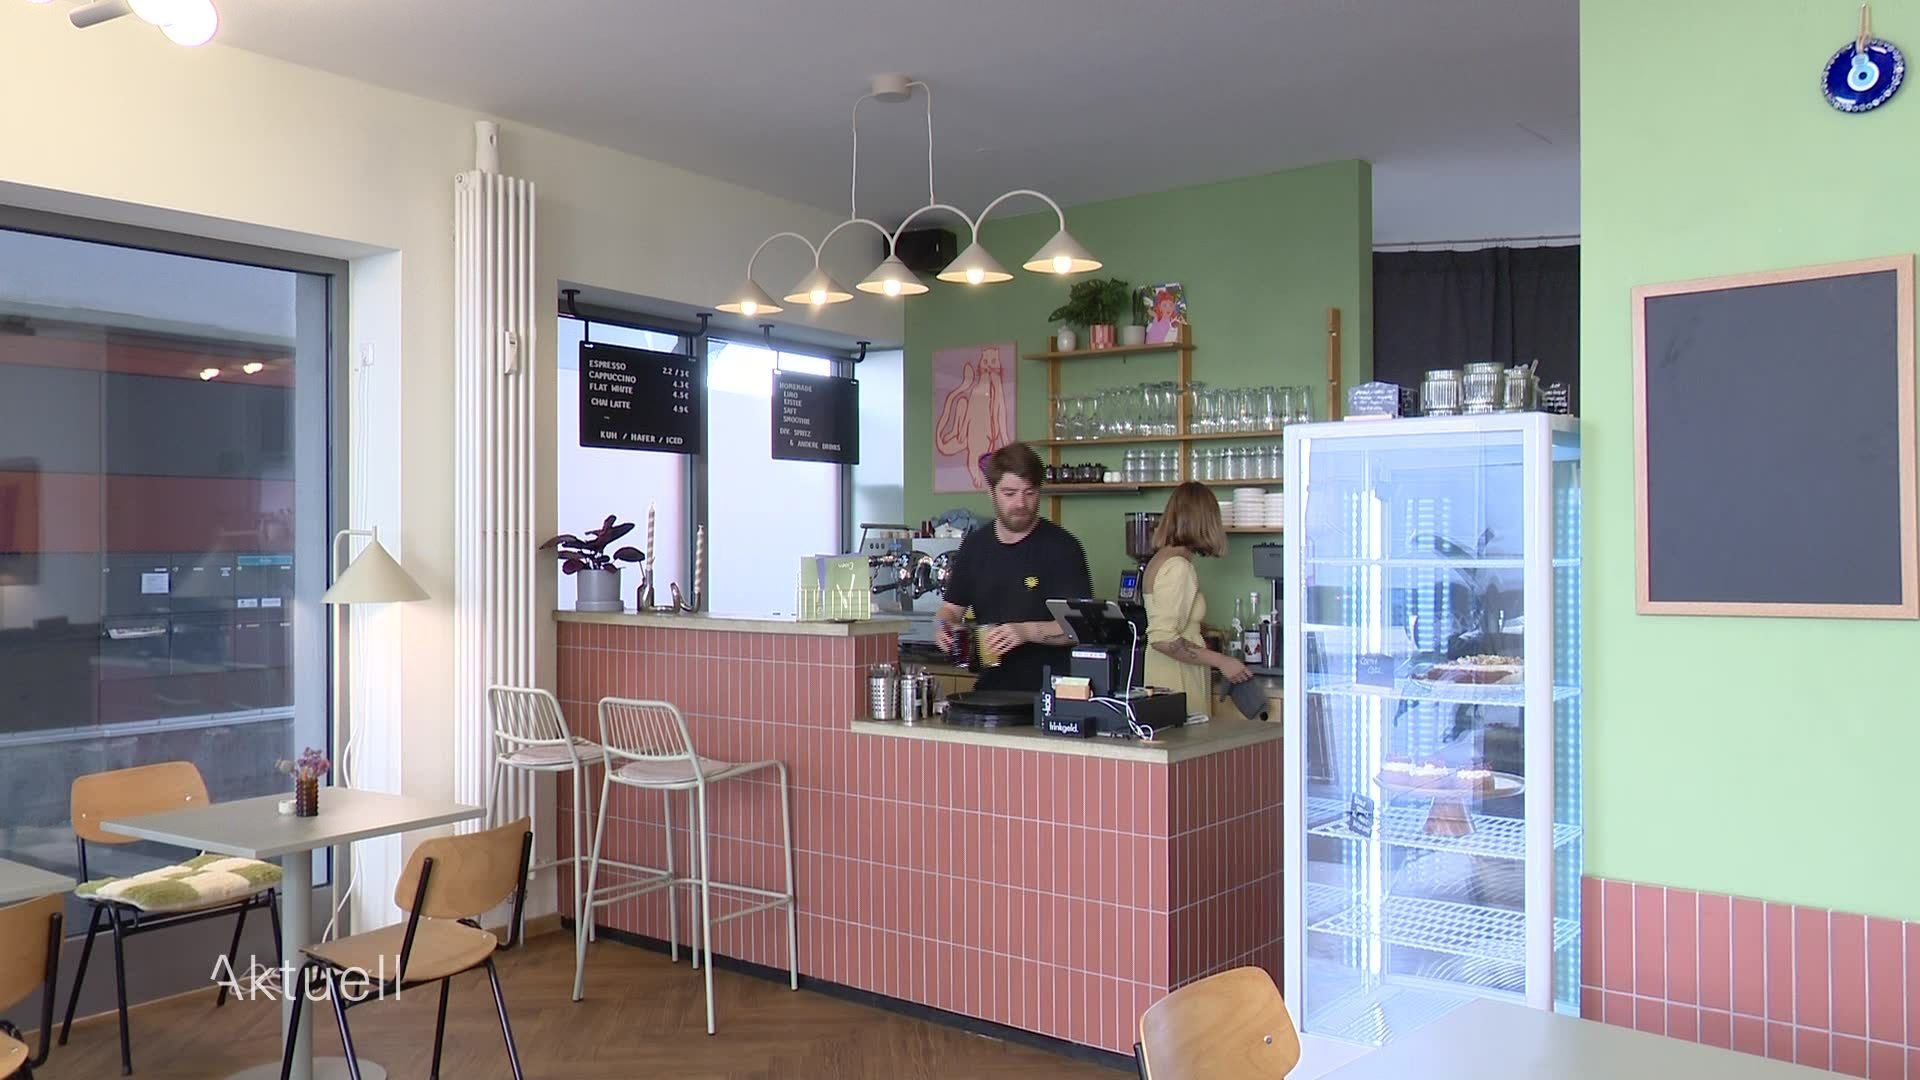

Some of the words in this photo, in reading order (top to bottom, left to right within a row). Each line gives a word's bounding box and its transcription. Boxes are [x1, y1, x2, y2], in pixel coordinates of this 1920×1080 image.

[589, 360, 626, 371] ESPRESSO
[588, 371, 637, 384] CAPPUCCINO
[589, 383, 608, 391] FLAT
[611, 384, 633, 394] WHITE
[591, 397, 608, 406] CHAI
[610, 399, 631, 409] LATTE
[600, 431, 617, 439] KUH
[630, 433, 656, 443] HAFER
[666, 436, 683, 445] ICED
